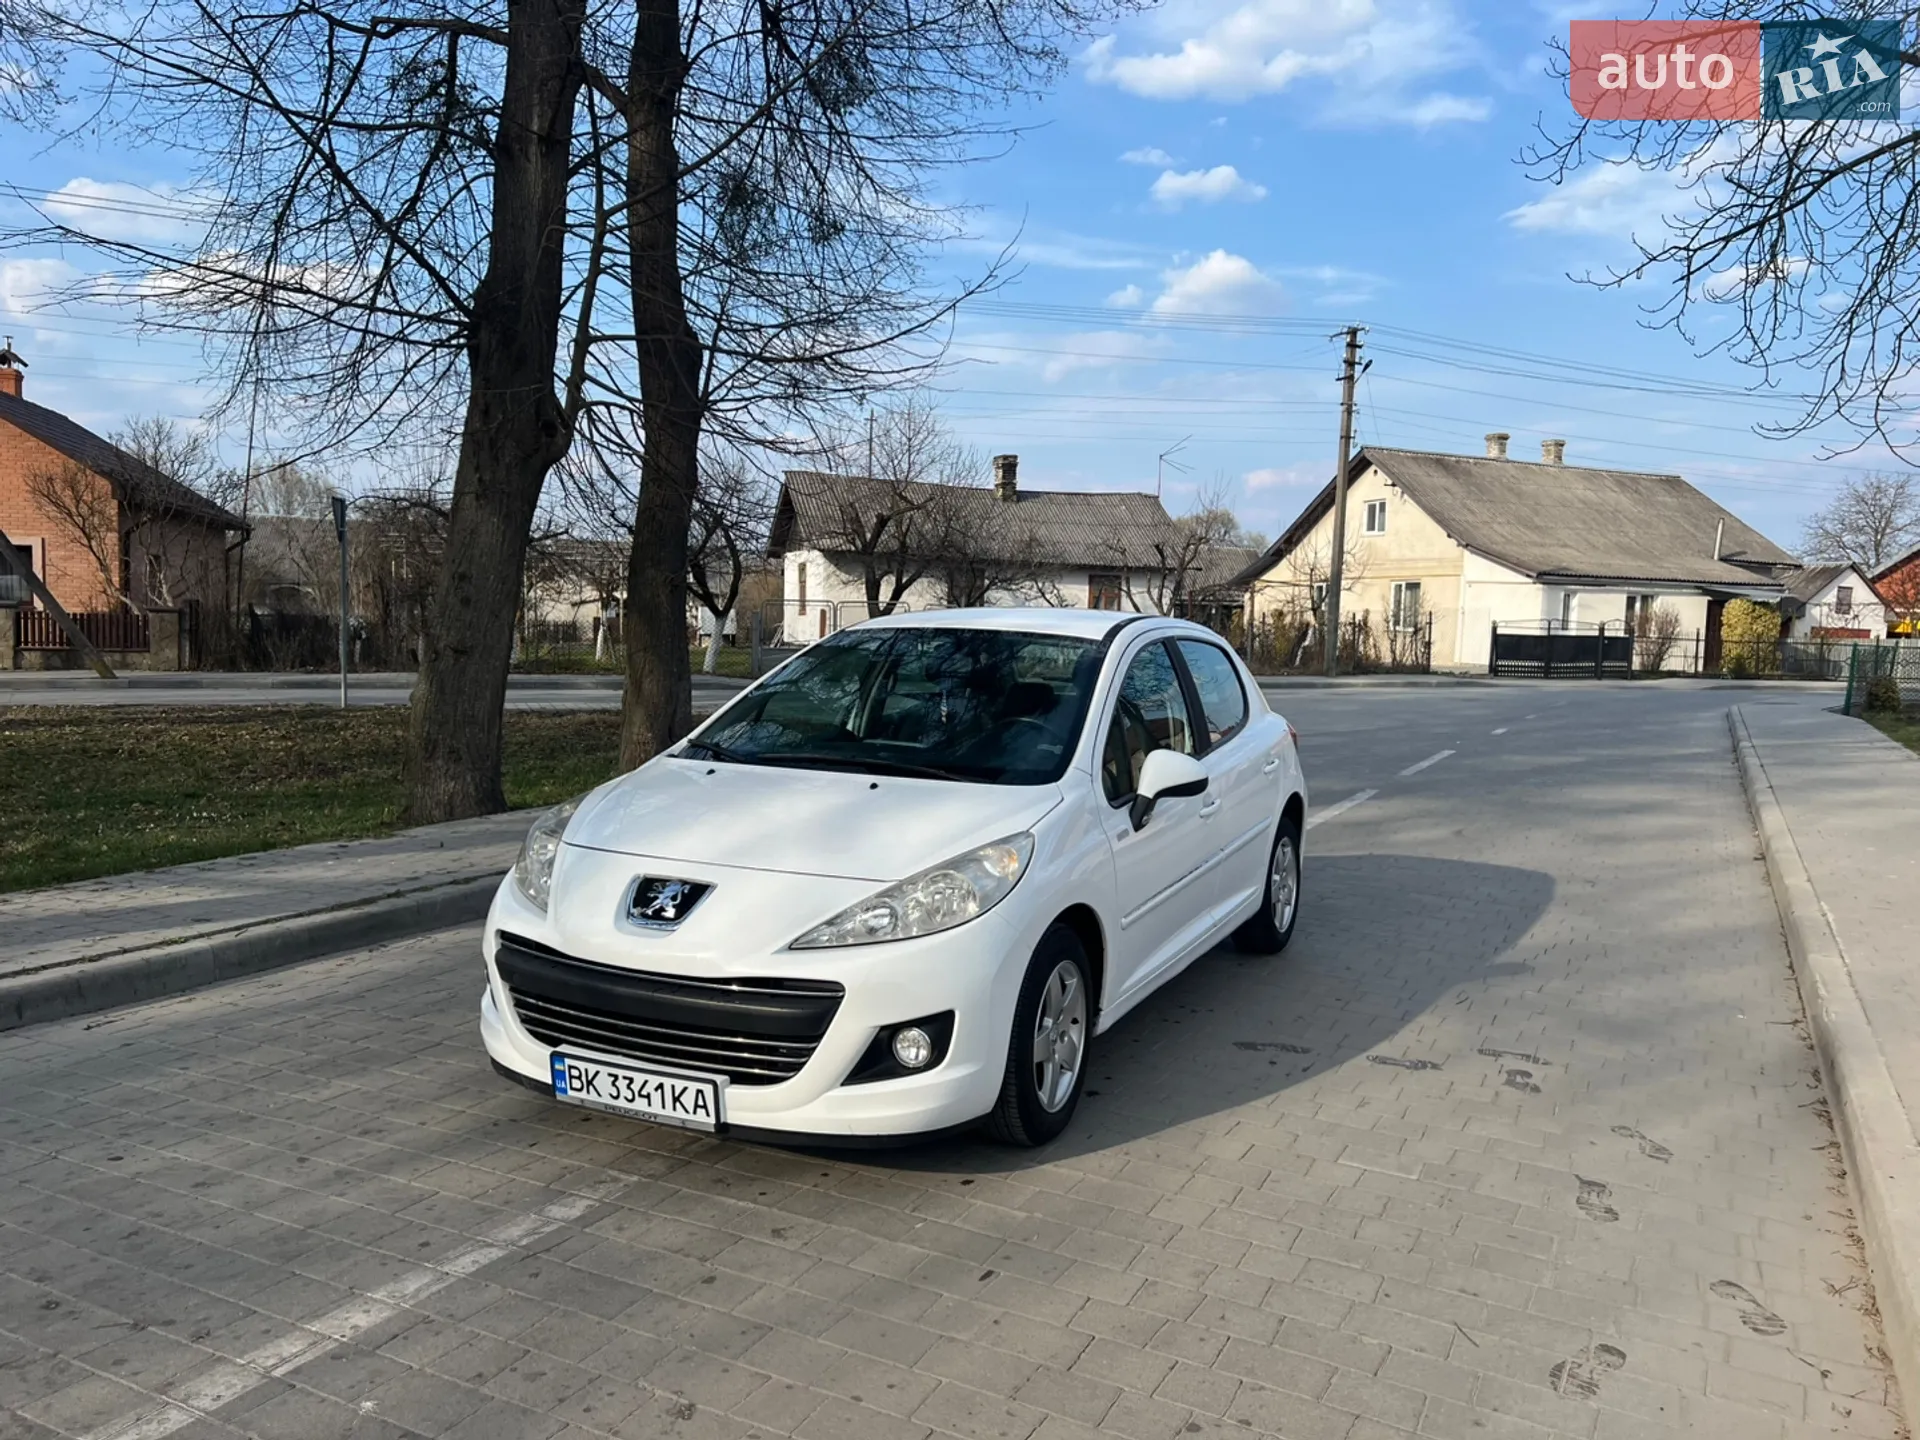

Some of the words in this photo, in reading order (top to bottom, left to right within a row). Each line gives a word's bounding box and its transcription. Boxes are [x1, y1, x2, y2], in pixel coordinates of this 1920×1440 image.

[556, 1080, 567, 1089] UA
[567, 1065, 602, 1098] BK
[607, 1073, 666, 1110] 3341
[671, 1083, 711, 1117] KA
